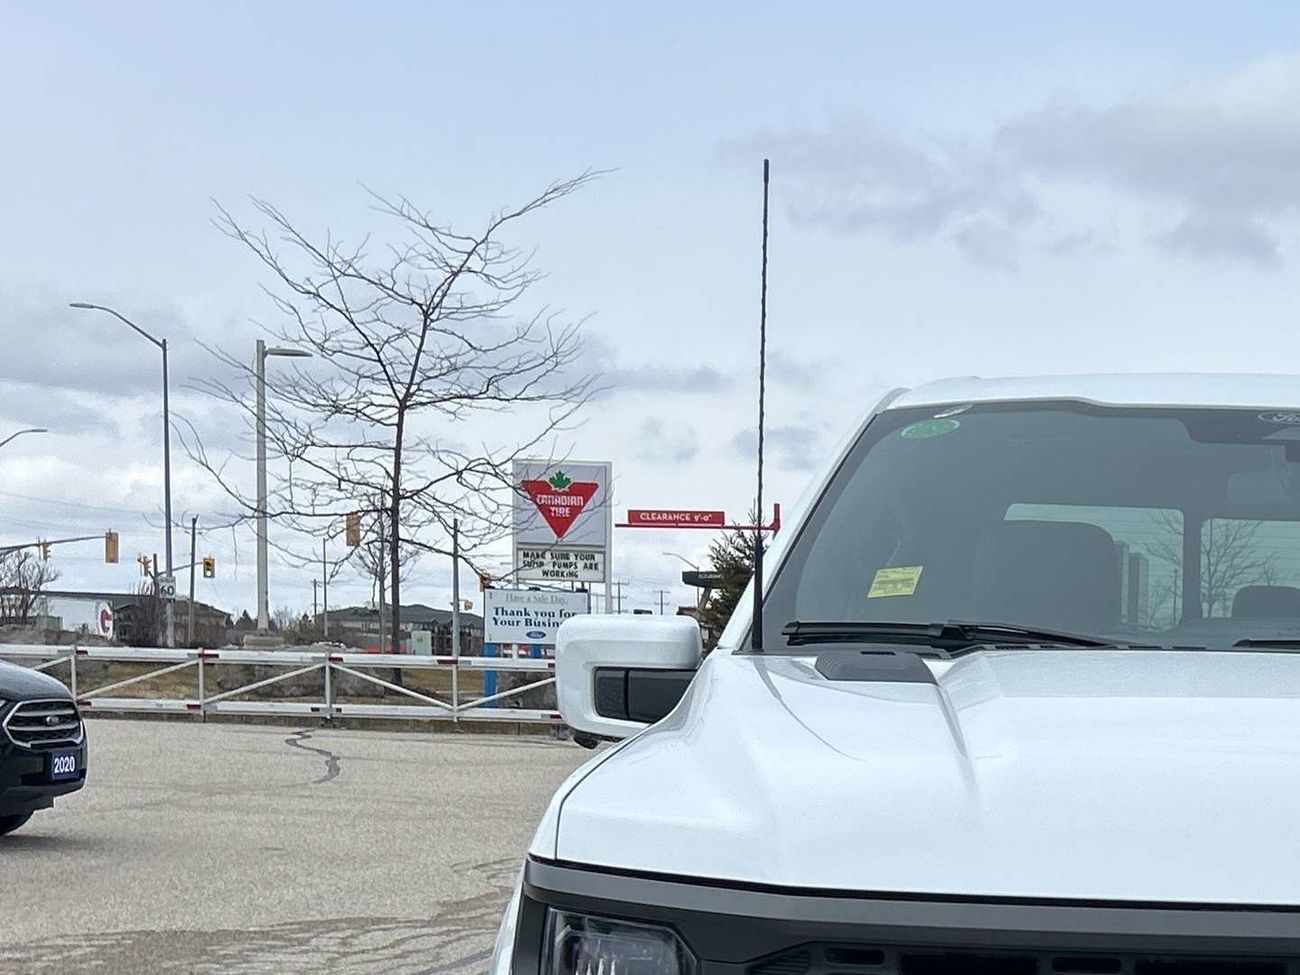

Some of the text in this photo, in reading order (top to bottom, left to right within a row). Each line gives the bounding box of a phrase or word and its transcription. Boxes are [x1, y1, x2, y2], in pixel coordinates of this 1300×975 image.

[536, 494, 584, 507] CANADIAN
[550, 506, 571, 518] TIRE
[639, 512, 691, 521] CLEARANCE
[550, 552, 570, 561] SURE
[573, 553, 596, 562] YOUR
[552, 561, 578, 570] PUMPS
[582, 562, 599, 571] ARE
[541, 569, 579, 579] WORKING
[160, 584, 175, 597] 60
[493, 606, 577, 619] Thank you for
[492, 616, 562, 628] Your Busin
[54, 755, 76, 774] 2020
